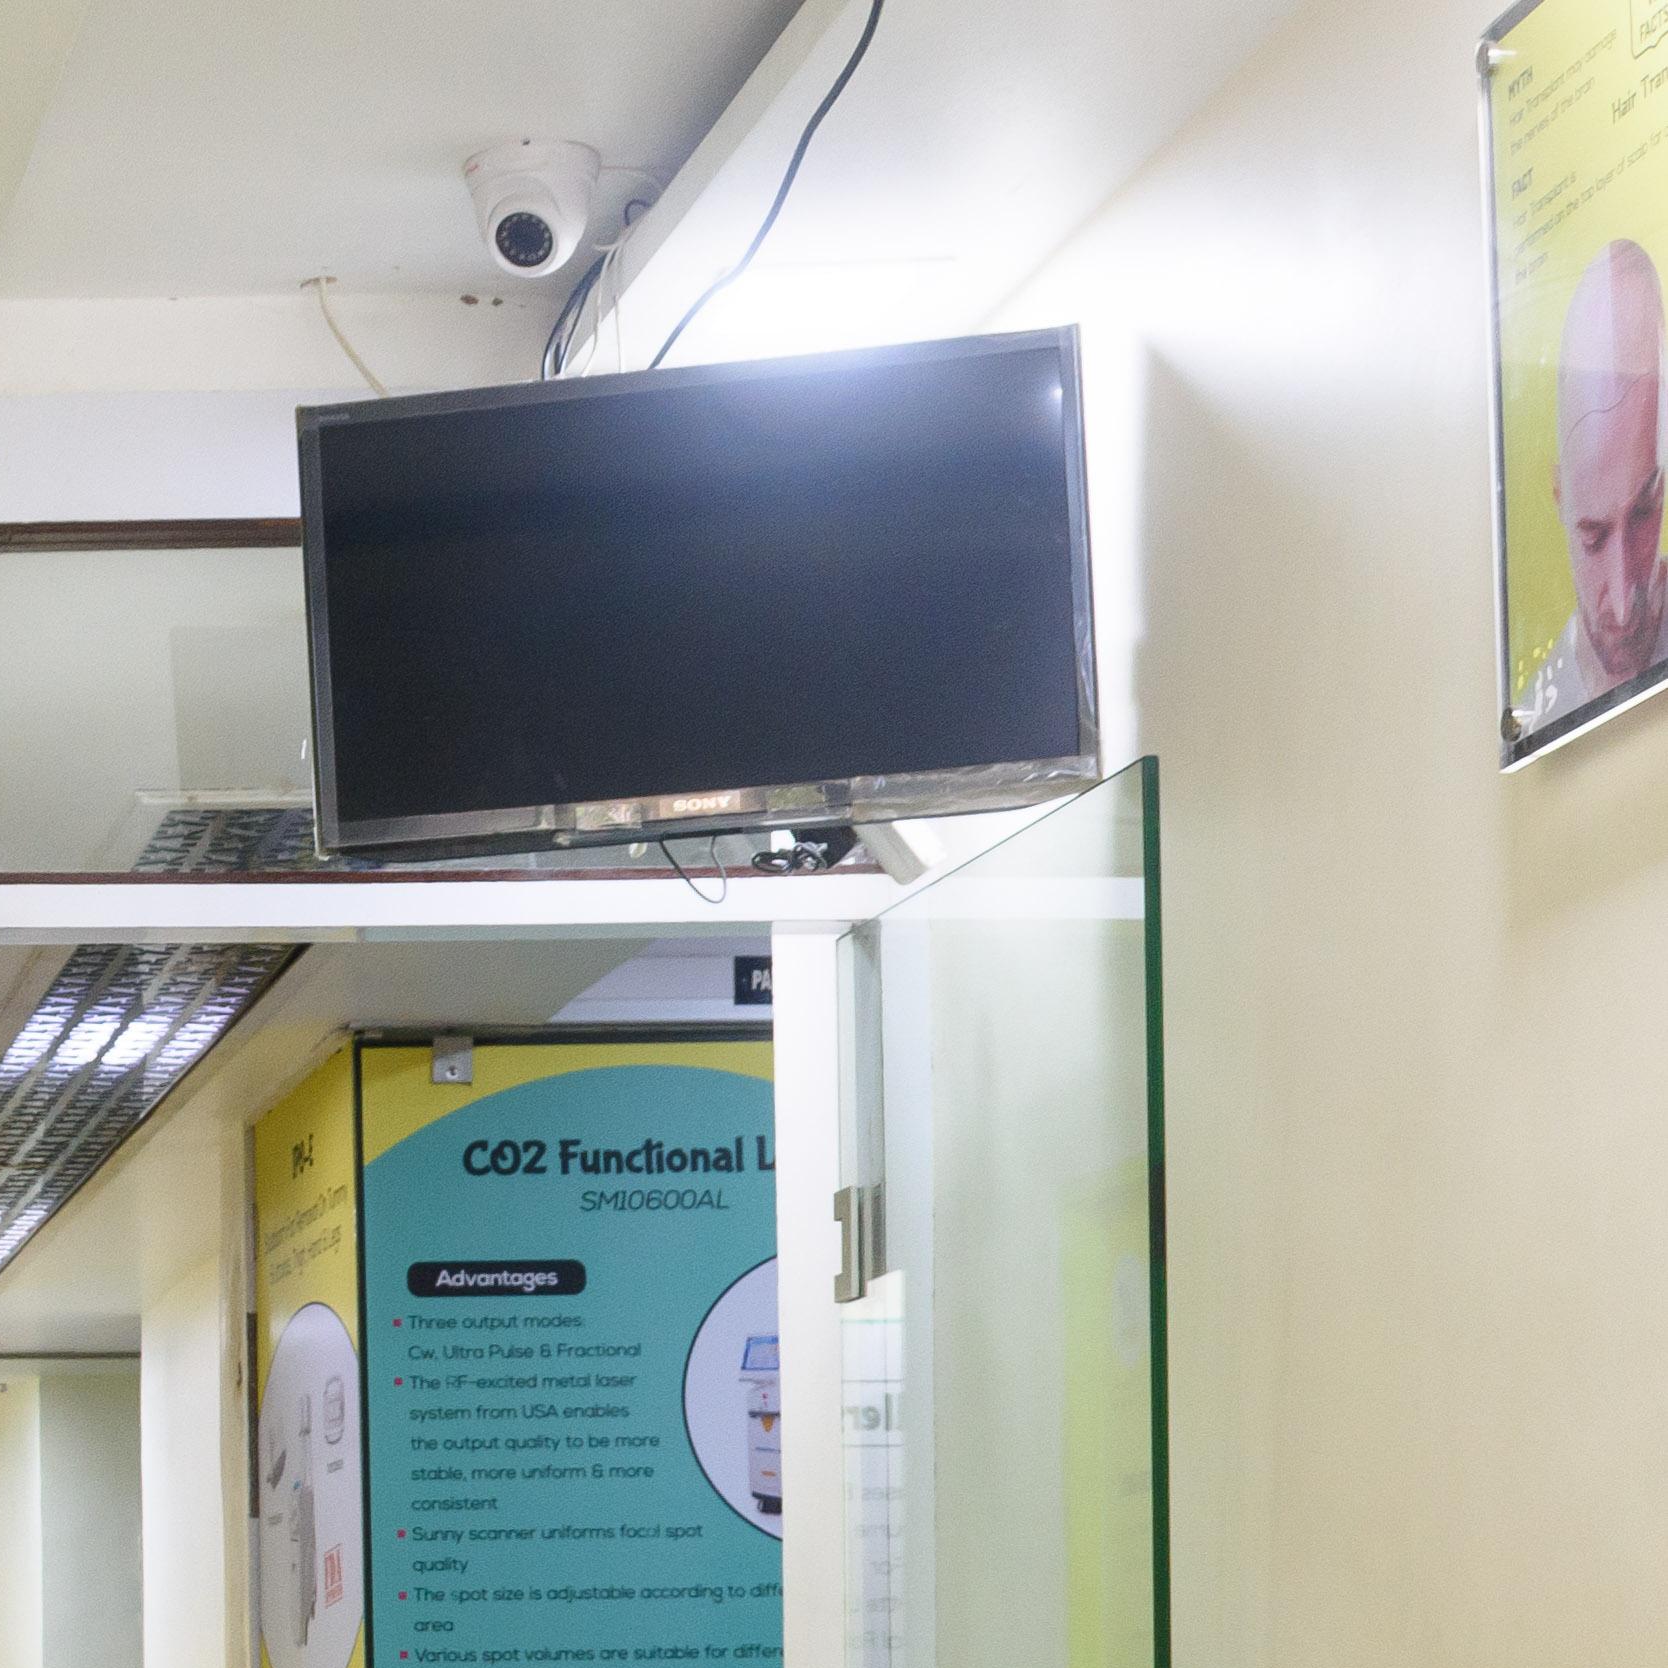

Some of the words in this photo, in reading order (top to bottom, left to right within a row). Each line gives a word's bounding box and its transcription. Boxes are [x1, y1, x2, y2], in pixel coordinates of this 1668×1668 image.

[1612, 92, 1636, 125] Hair
[673, 796, 732, 811] SONY
[462, 1140, 547, 1176] CO2
[559, 1137, 744, 1175] Functional
[436, 1269, 558, 1293] Advantages
[408, 1315, 457, 1329] Three
[462, 1316, 518, 1331] output
[409, 1407, 471, 1423] system
[475, 1405, 517, 1419] from
[522, 1404, 558, 1419] USA
[562, 1404, 630, 1419] enables
[411, 1437, 438, 1451] the
[442, 1437, 499, 1452] output
[504, 1435, 560, 1451] quality
[565, 1435, 584, 1449] to
[588, 1435, 610, 1448] be
[614, 1436, 660, 1448] more
[411, 1498, 498, 1511] consistent
[412, 1557, 468, 1574] quality
[414, 1621, 454, 1632] area
